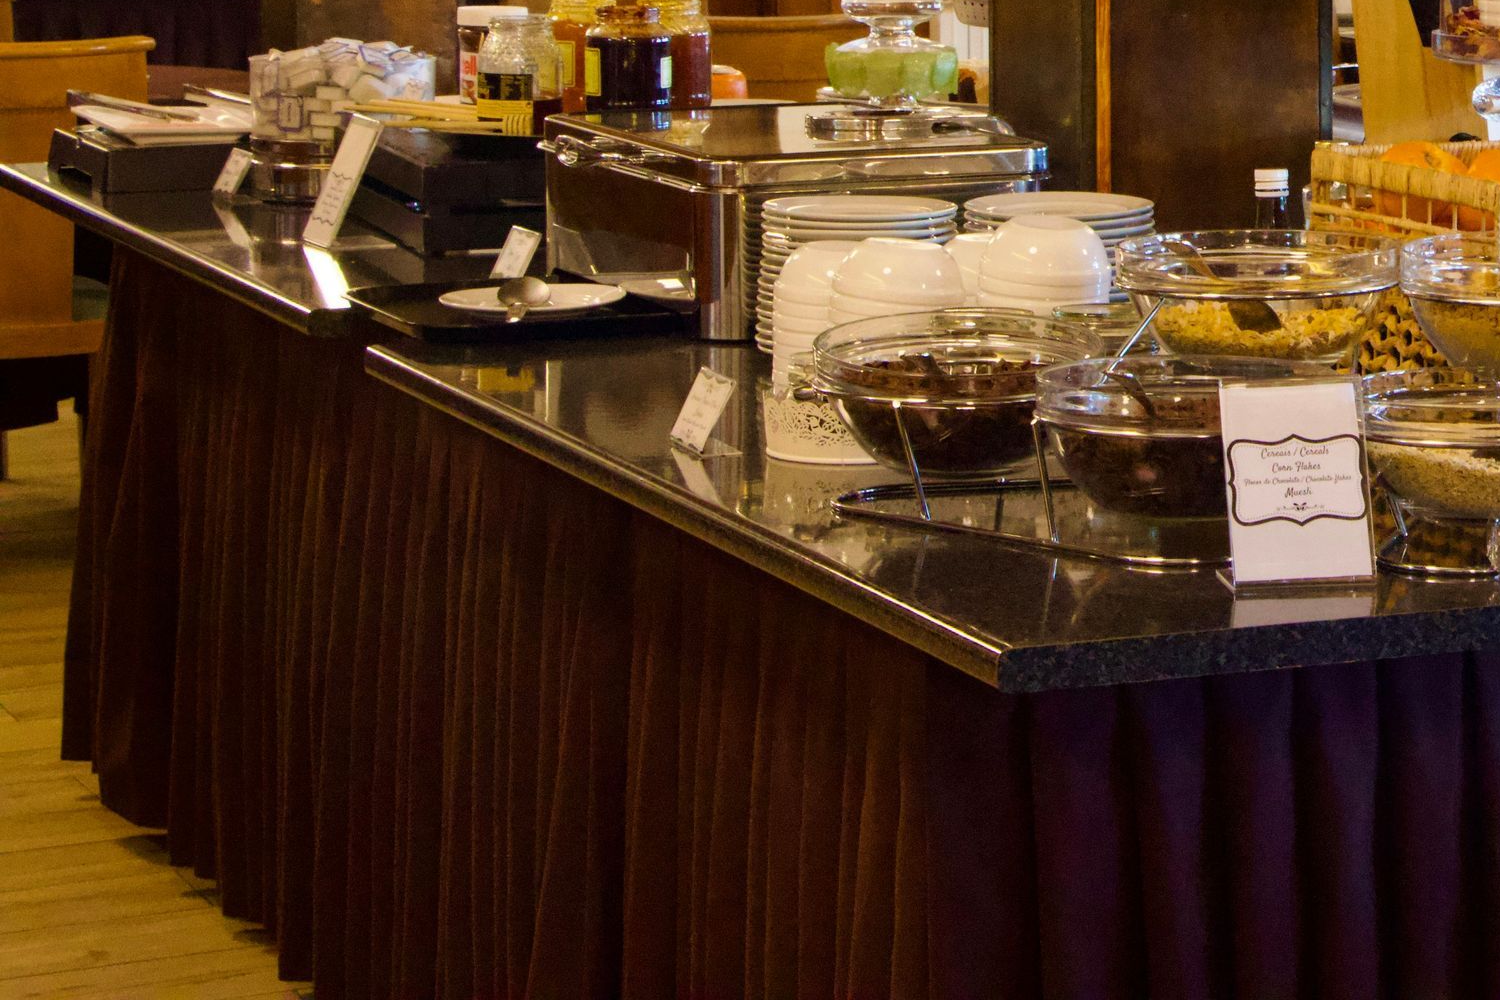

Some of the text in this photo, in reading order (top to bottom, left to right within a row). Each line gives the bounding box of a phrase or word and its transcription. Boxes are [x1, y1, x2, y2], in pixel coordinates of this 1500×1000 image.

[1261, 447, 1292, 459] Cereais
[1300, 445, 1329, 457] Cereals
[1272, 461, 1321, 473] Corn Flakes
[1305, 474, 1333, 484] Chocolate
[1285, 487, 1312, 498] Muesli
